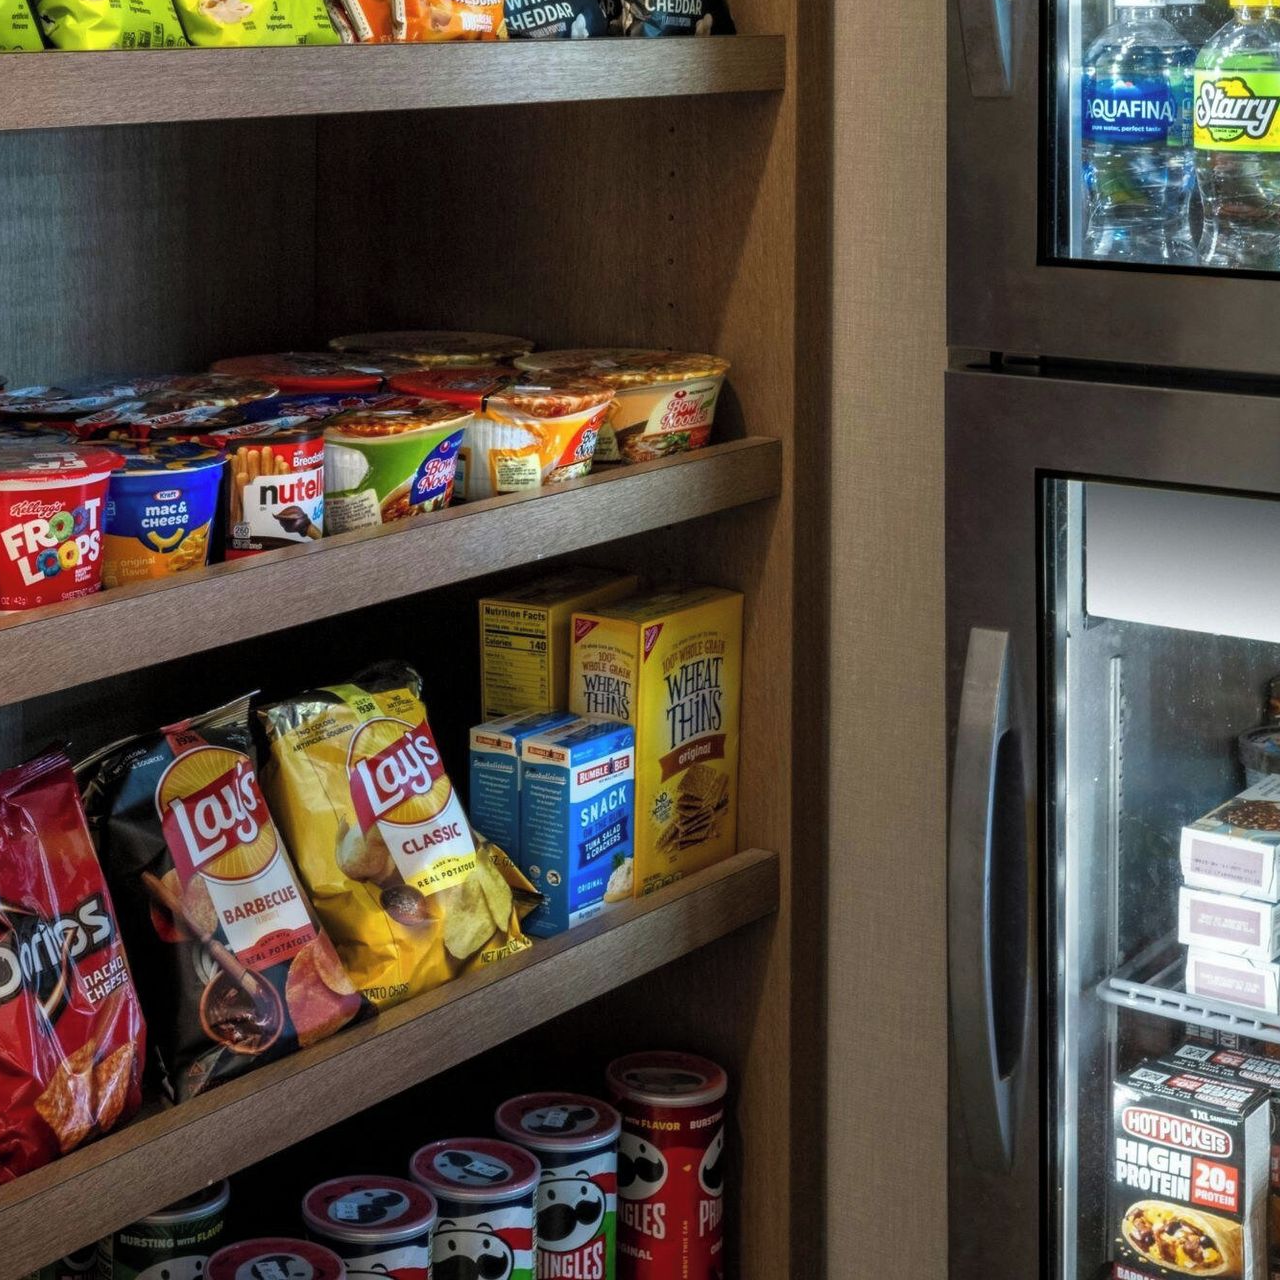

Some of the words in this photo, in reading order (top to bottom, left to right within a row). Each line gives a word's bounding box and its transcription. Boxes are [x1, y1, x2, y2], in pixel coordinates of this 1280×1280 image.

[1085, 99, 1174, 123] AQUAFINA
[1197, 83, 1280, 138] Starry
[9, 500, 63, 518] Kellogg's
[145, 503, 178, 517] mac
[178, 501, 188, 514] &
[120, 556, 156, 570] original
[484, 606, 521, 619] Nutrition
[522, 610, 546, 622] Facts
[530, 641, 547, 651] 140
[582, 674, 632, 698] WHEAT
[664, 657, 725, 706] WHEAT
[356, 701, 377, 715] 1938
[678, 743, 712, 765] original
[355, 731, 439, 817] Lay's
[579, 764, 609, 785] BUMBLE
[613, 758, 630, 772] BEE
[170, 760, 258, 869] Lay's
[580, 785, 627, 827] SNACK
[402, 822, 462, 856] CLASSIC
[584, 837, 601, 853] TUNA
[602, 823, 620, 841] SALAD
[417, 874, 439, 888] REAL
[441, 860, 476, 880] POTATOES
[577, 877, 604, 895] ORIGINAL
[222, 884, 297, 926] BARBECUE
[85, 971, 129, 1006] CHEESE
[640, 1119, 681, 1132] FLAVOR
[1128, 1110, 1160, 1135] HOT
[1160, 1117, 1227, 1154] POCKETS
[1116, 1137, 1192, 1176] HIGH
[1115, 1160, 1191, 1202] PROTEIN
[1195, 1162, 1236, 1195] 20g
[1195, 1190, 1236, 1208] PROTEIN
[120, 1234, 175, 1250] BURSTING
